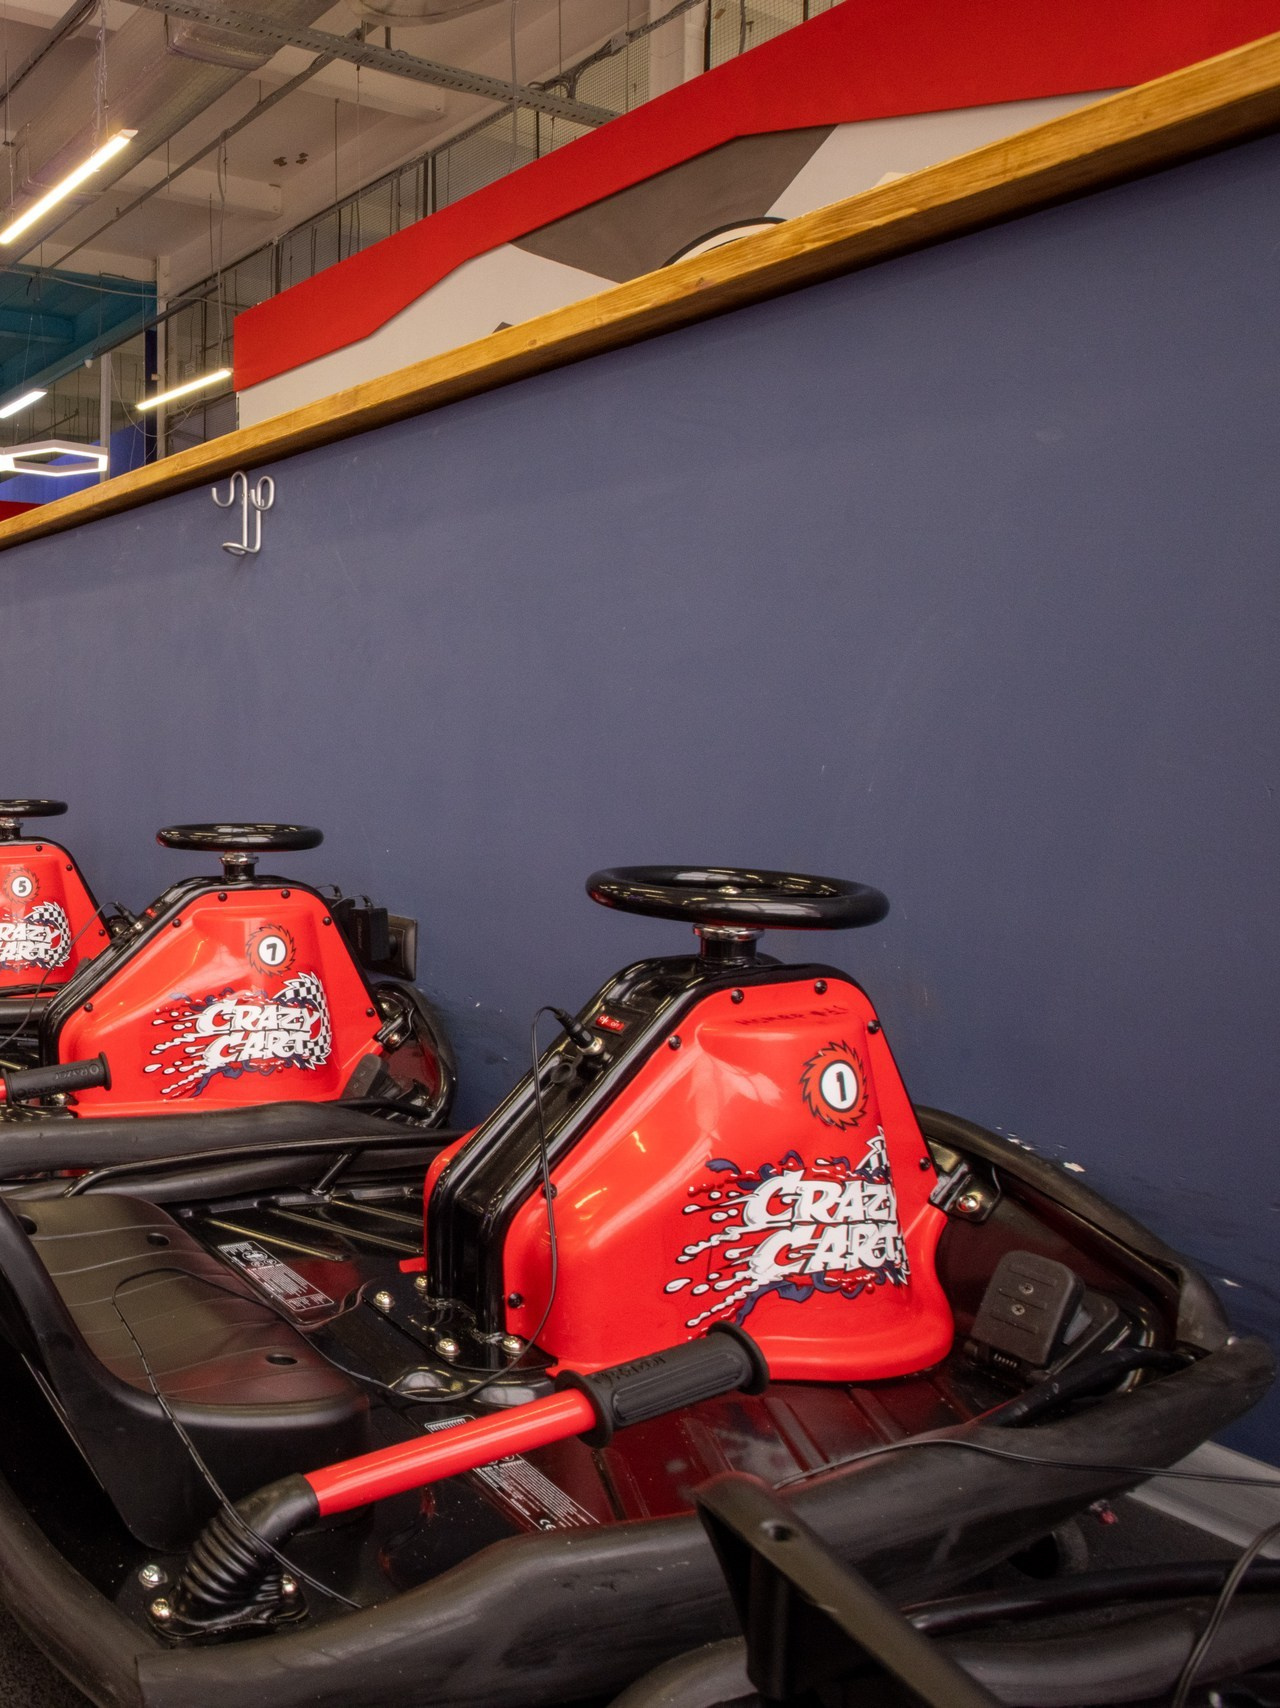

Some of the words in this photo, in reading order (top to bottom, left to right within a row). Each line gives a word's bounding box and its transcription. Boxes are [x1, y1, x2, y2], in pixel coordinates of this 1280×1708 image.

[19, 881, 26, 893] 5
[266, 943, 277, 961] 7
[196, 998, 320, 1035] CRAZY
[204, 1031, 310, 1066] CART
[835, 1071, 847, 1102] 1
[749, 1224, 900, 1276] CART
